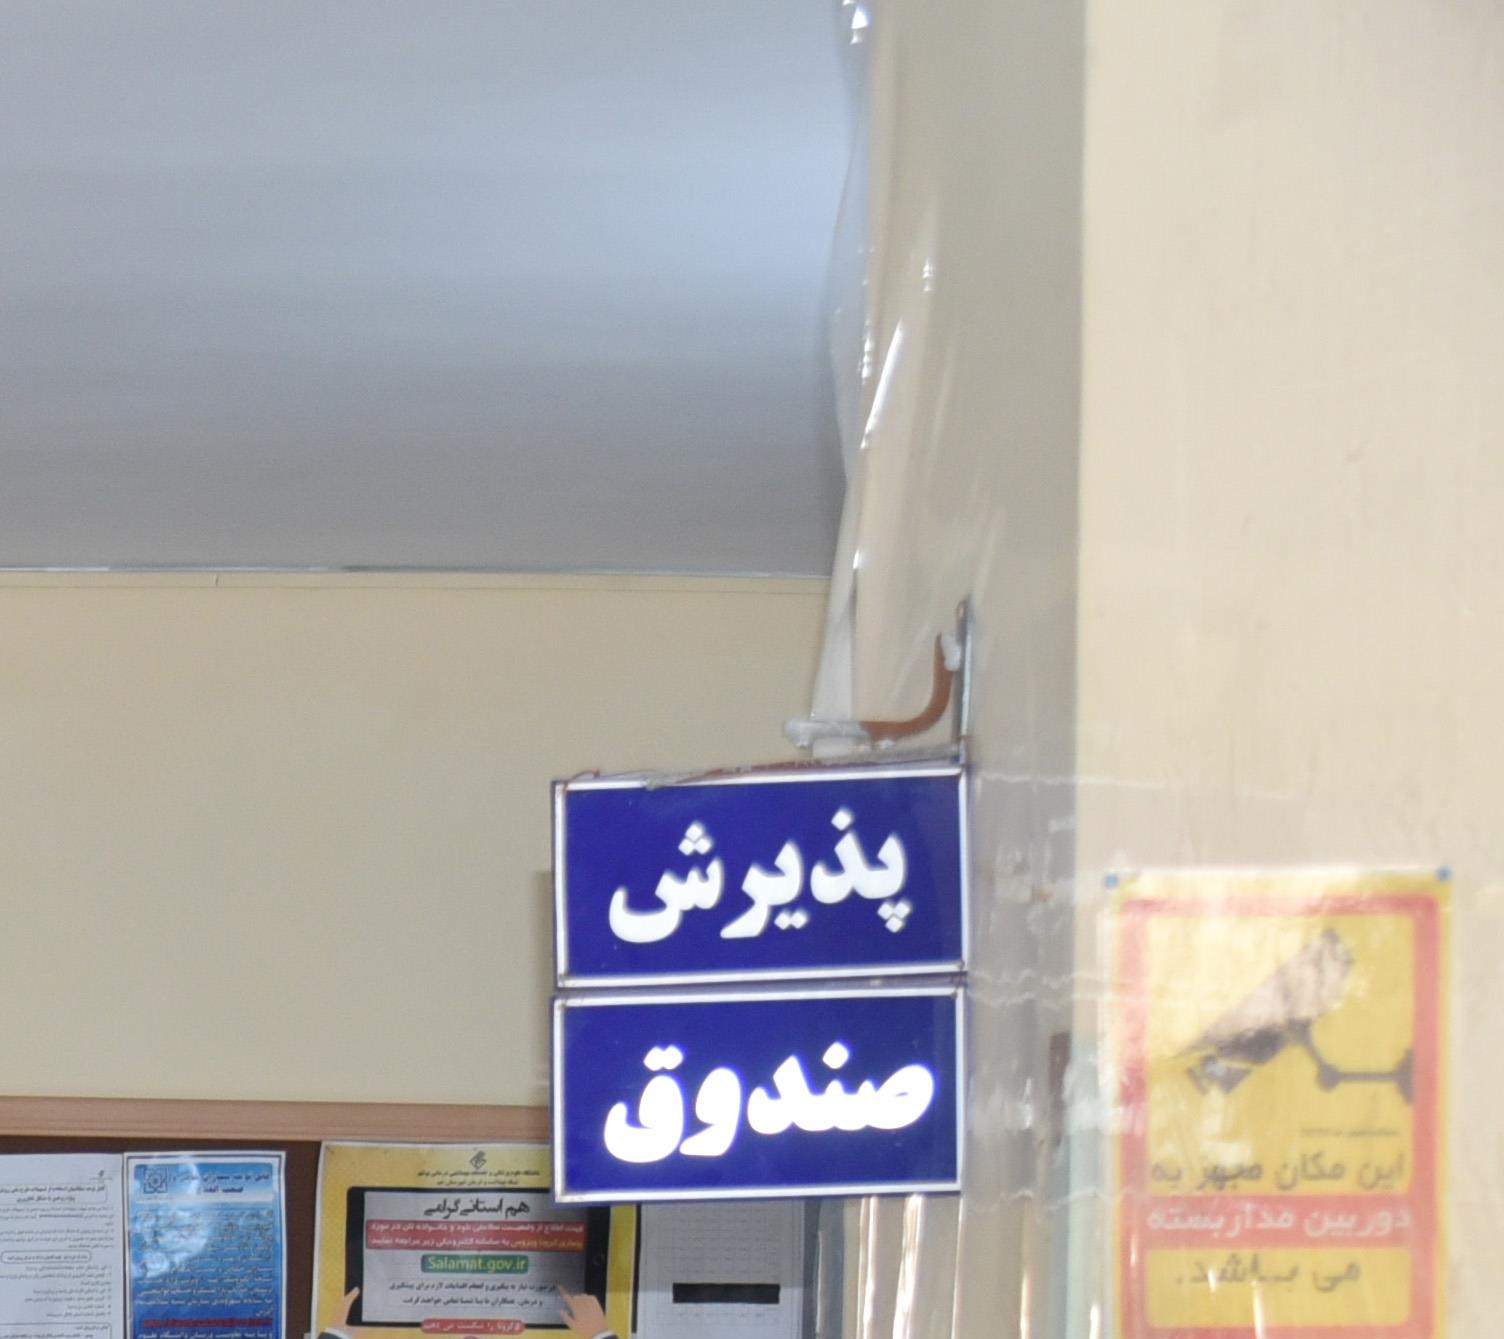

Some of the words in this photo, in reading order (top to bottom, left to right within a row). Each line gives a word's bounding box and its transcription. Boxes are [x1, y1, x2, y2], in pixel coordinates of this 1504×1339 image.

[607, 807, 909, 945] پذیرش
[604, 1040, 935, 1165] صندوق
[1197, 1155, 1263, 1191] مجهز
[1275, 1152, 1345, 1191] مکان
[1359, 1153, 1406, 1189] این
[1304, 1207, 1412, 1237] دوربین
[428, 1256, 526, 1275] Salamat.gov.ir
[1313, 1261, 1361, 1292] می
